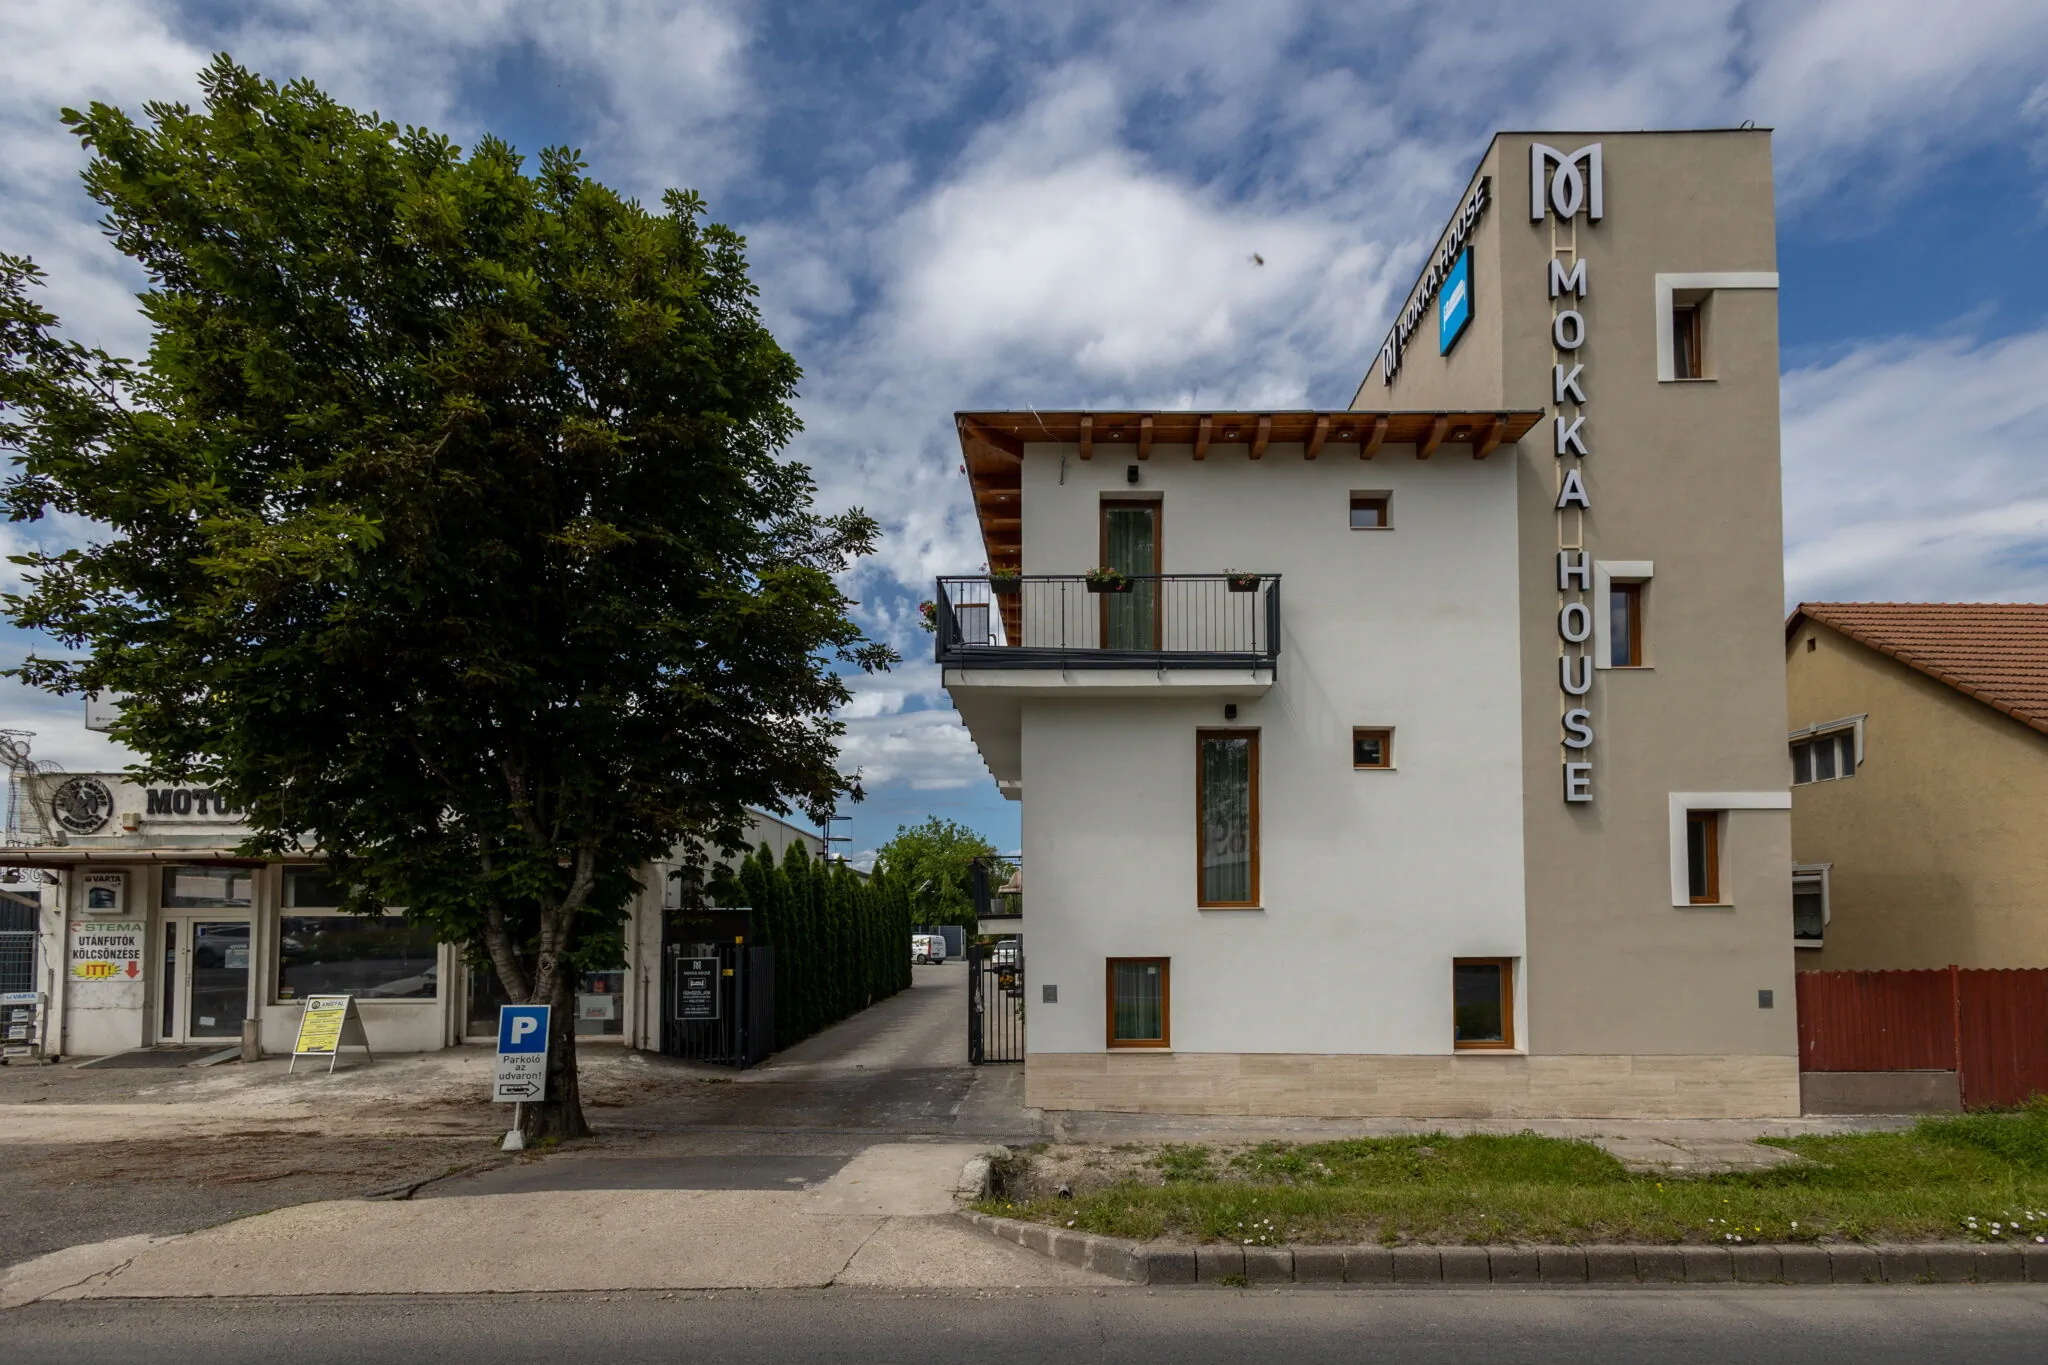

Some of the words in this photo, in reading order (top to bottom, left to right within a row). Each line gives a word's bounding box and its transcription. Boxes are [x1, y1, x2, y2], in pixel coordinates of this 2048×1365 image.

[1400, 265, 1440, 346] MOKKA
[1440, 176, 1492, 275] HOUSE
[1548, 258, 1590, 509] MOKKA
[1556, 551, 1593, 803] HOUSE
[147, 788, 248, 815] MOTO
[85, 923, 142, 932] STEMA
[79, 934, 135, 946] UTÁNFUTÓK
[72, 948, 141, 960] KÖLCSÖNZÉSE
[86, 964, 112, 976] ITT!
[511, 1016, 538, 1044] P
[503, 1054, 541, 1063] Parkoló
[499, 1072, 542, 1080] udvaron!
